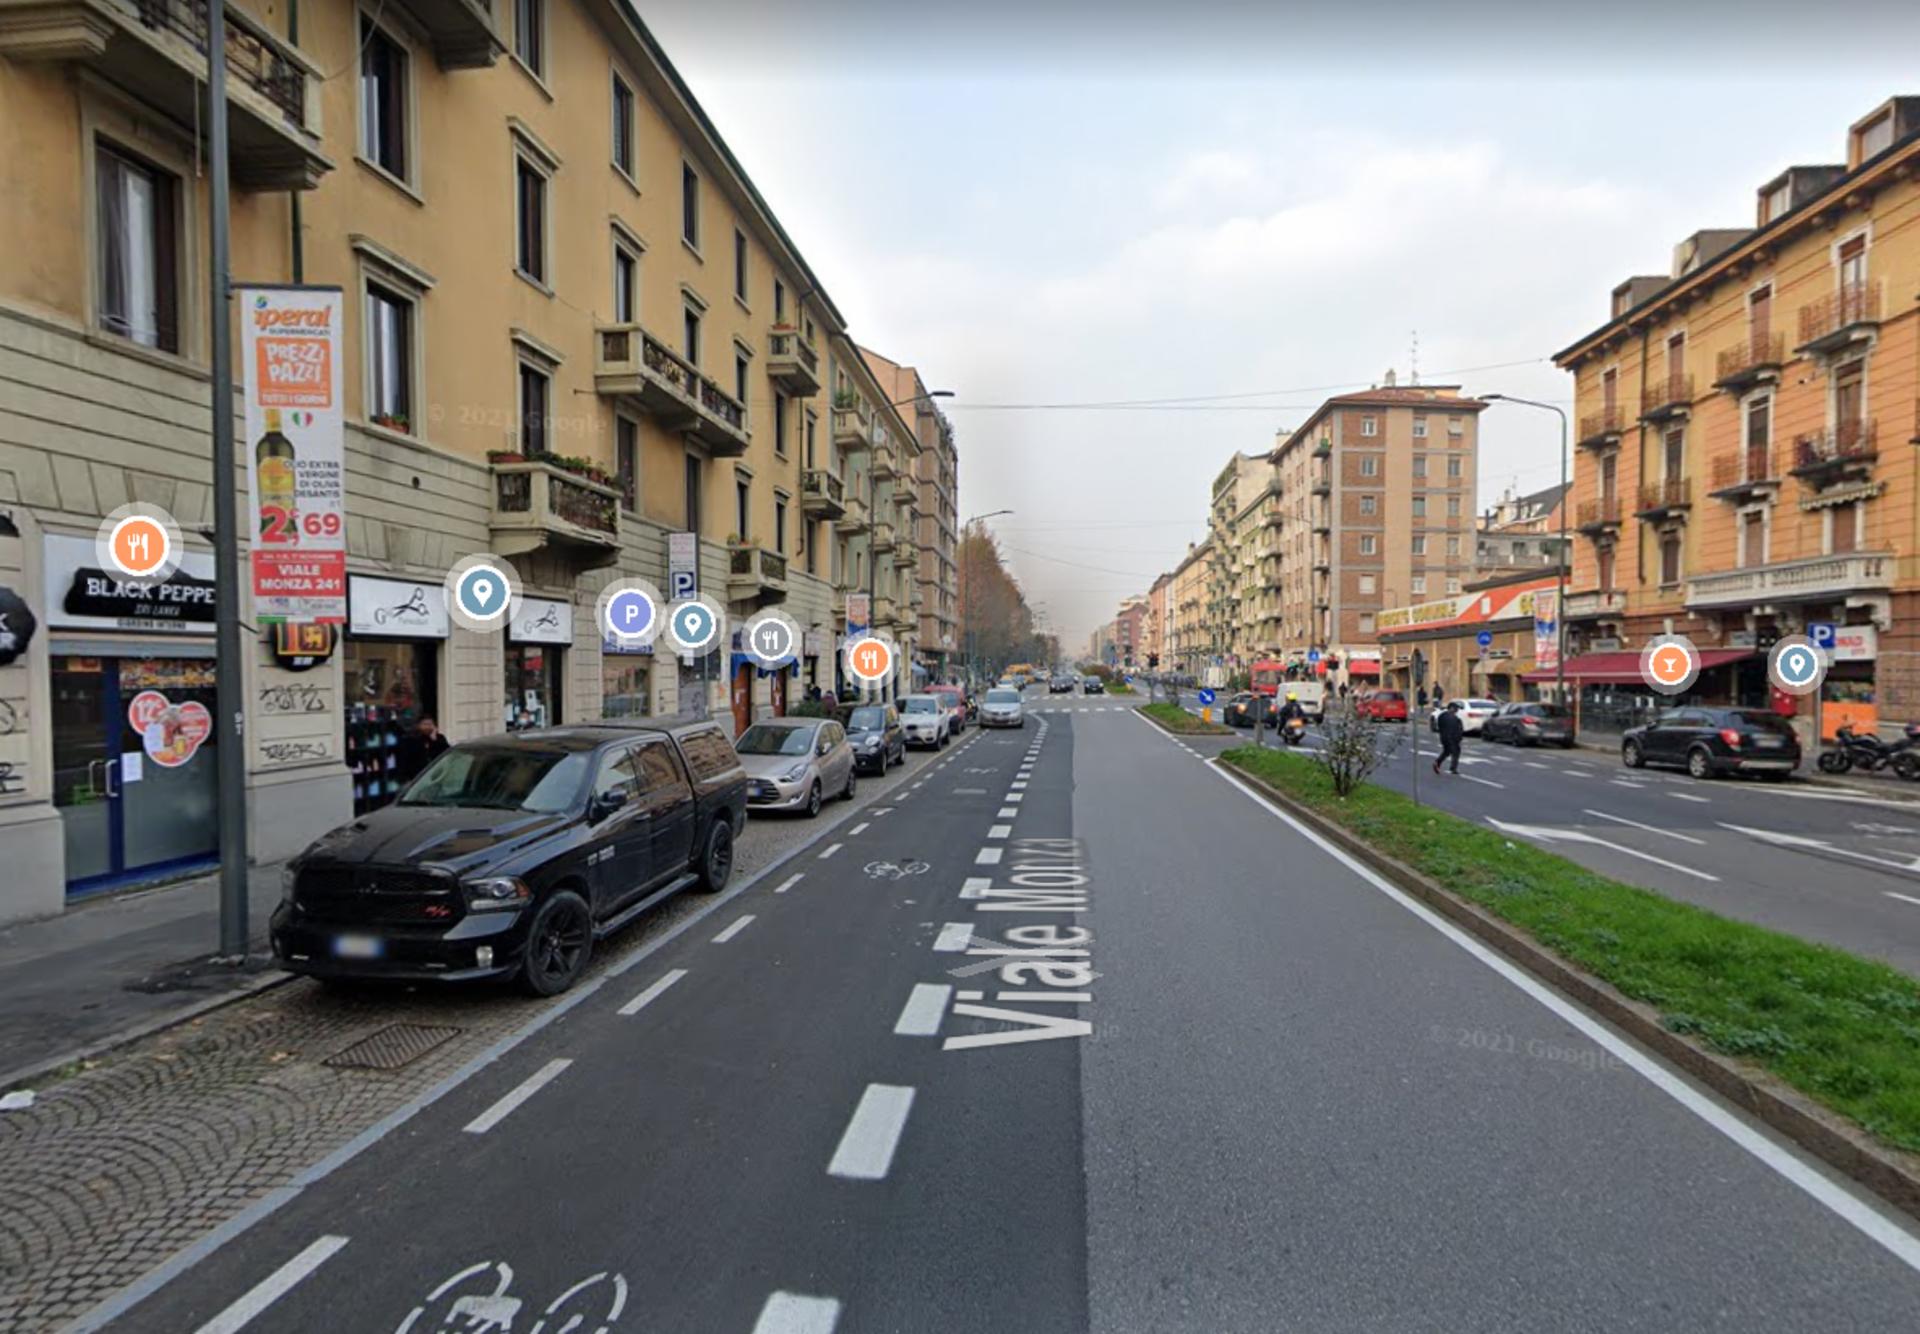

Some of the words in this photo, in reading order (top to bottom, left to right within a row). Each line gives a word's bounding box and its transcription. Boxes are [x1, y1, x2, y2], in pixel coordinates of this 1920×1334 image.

[266, 343, 325, 363] PREZZI
[268, 361, 321, 384] PAZZI
[297, 470, 340, 479] VERGINE
[309, 461, 340, 469] EXTRA
[278, 564, 320, 576] VIALE
[86, 577, 153, 600] BLACK
[159, 583, 216, 604] PEPPE
[260, 579, 313, 590] MONZA
[315, 579, 341, 590] 241
[674, 573, 691, 599] P
[1813, 626, 1831, 647] P
